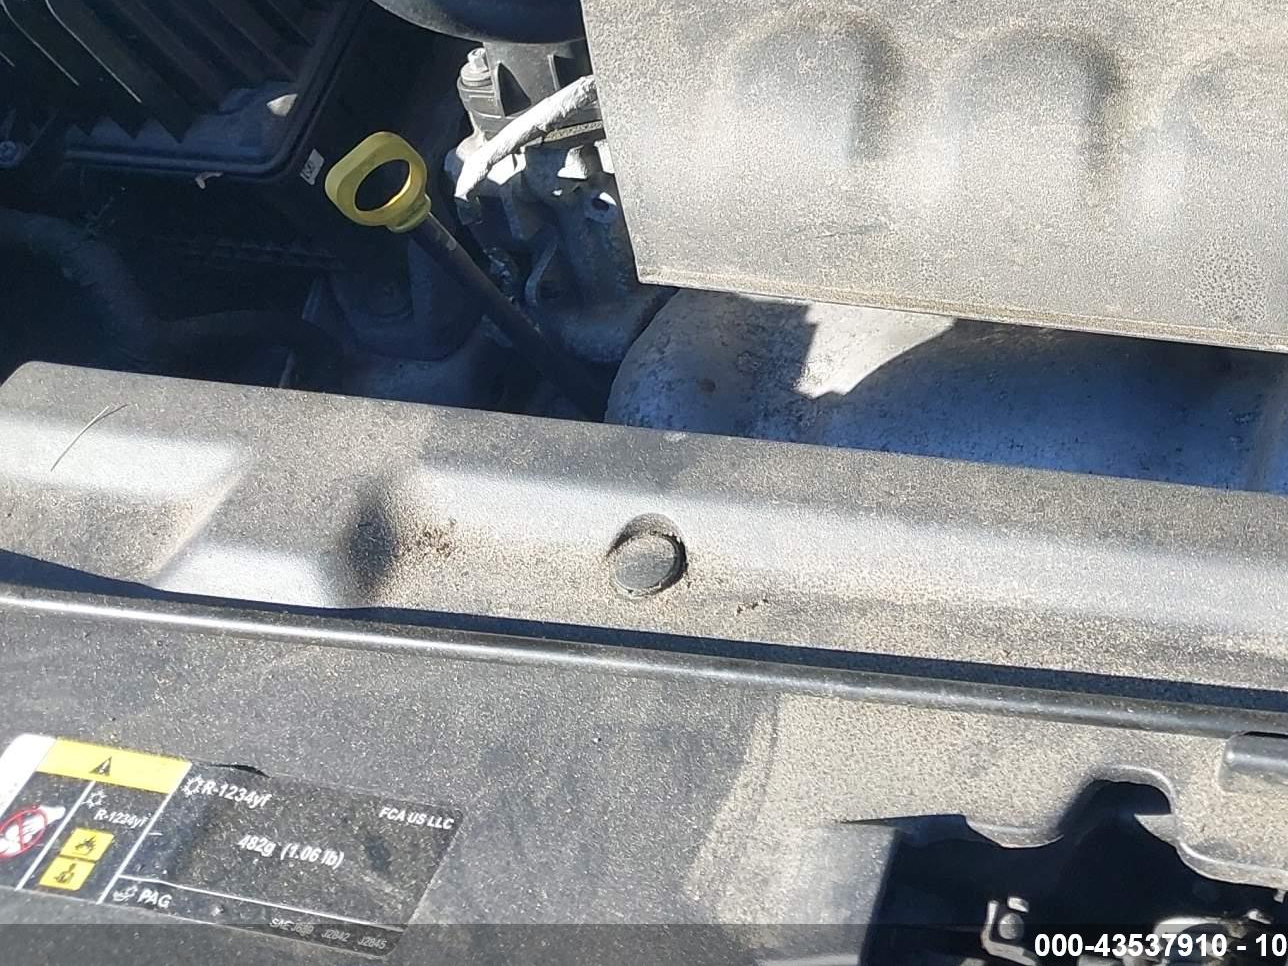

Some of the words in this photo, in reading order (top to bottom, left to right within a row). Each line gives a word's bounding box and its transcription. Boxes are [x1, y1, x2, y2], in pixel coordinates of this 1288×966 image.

[200, 779, 273, 809] R-1234yf
[93, 809, 150, 830] R-1234yf
[379, 806, 405, 823] FCA
[407, 812, 425, 825] US
[427, 816, 455, 830] LLC
[237, 834, 277, 858] 482g
[280, 841, 322, 864] (1.06
[321, 847, 345, 870] lb)
[137, 888, 173, 909] PAG
